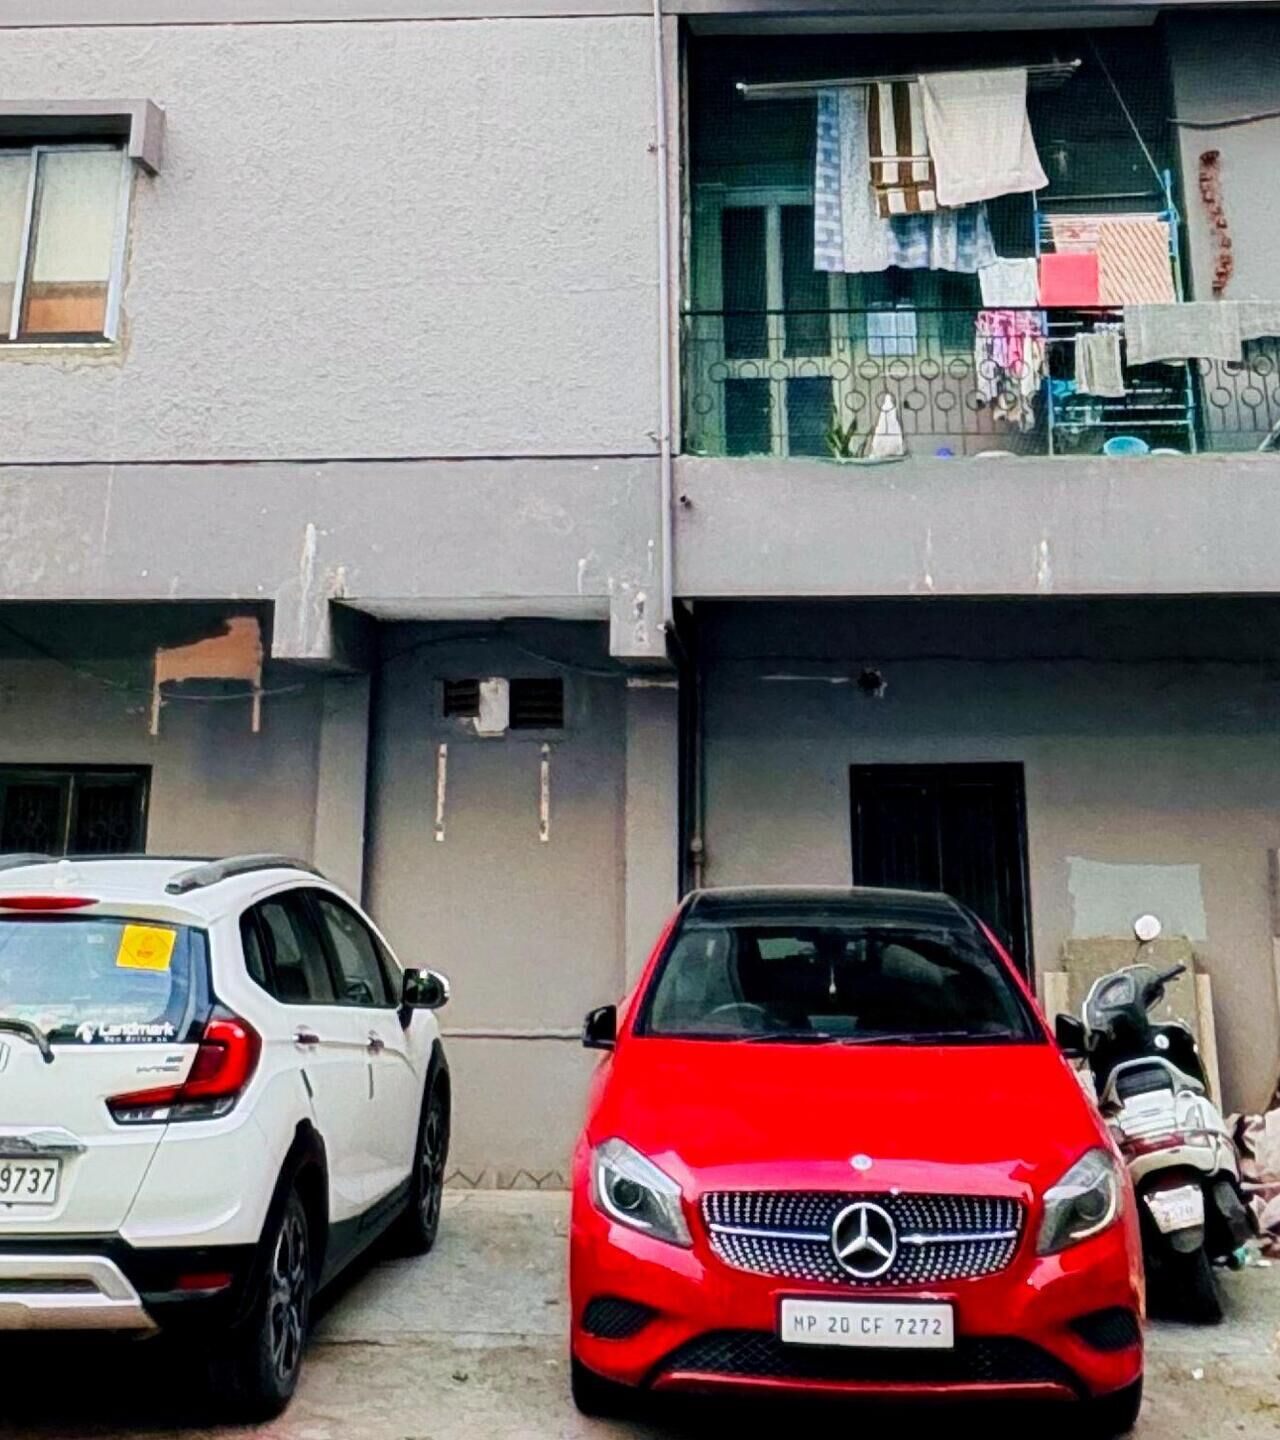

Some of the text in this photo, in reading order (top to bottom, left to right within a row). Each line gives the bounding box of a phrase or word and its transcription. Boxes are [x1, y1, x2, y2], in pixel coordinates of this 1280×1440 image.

[98, 1021, 176, 1037] Landmark
[793, 1315, 943, 1335] MP 20 CF 7272
